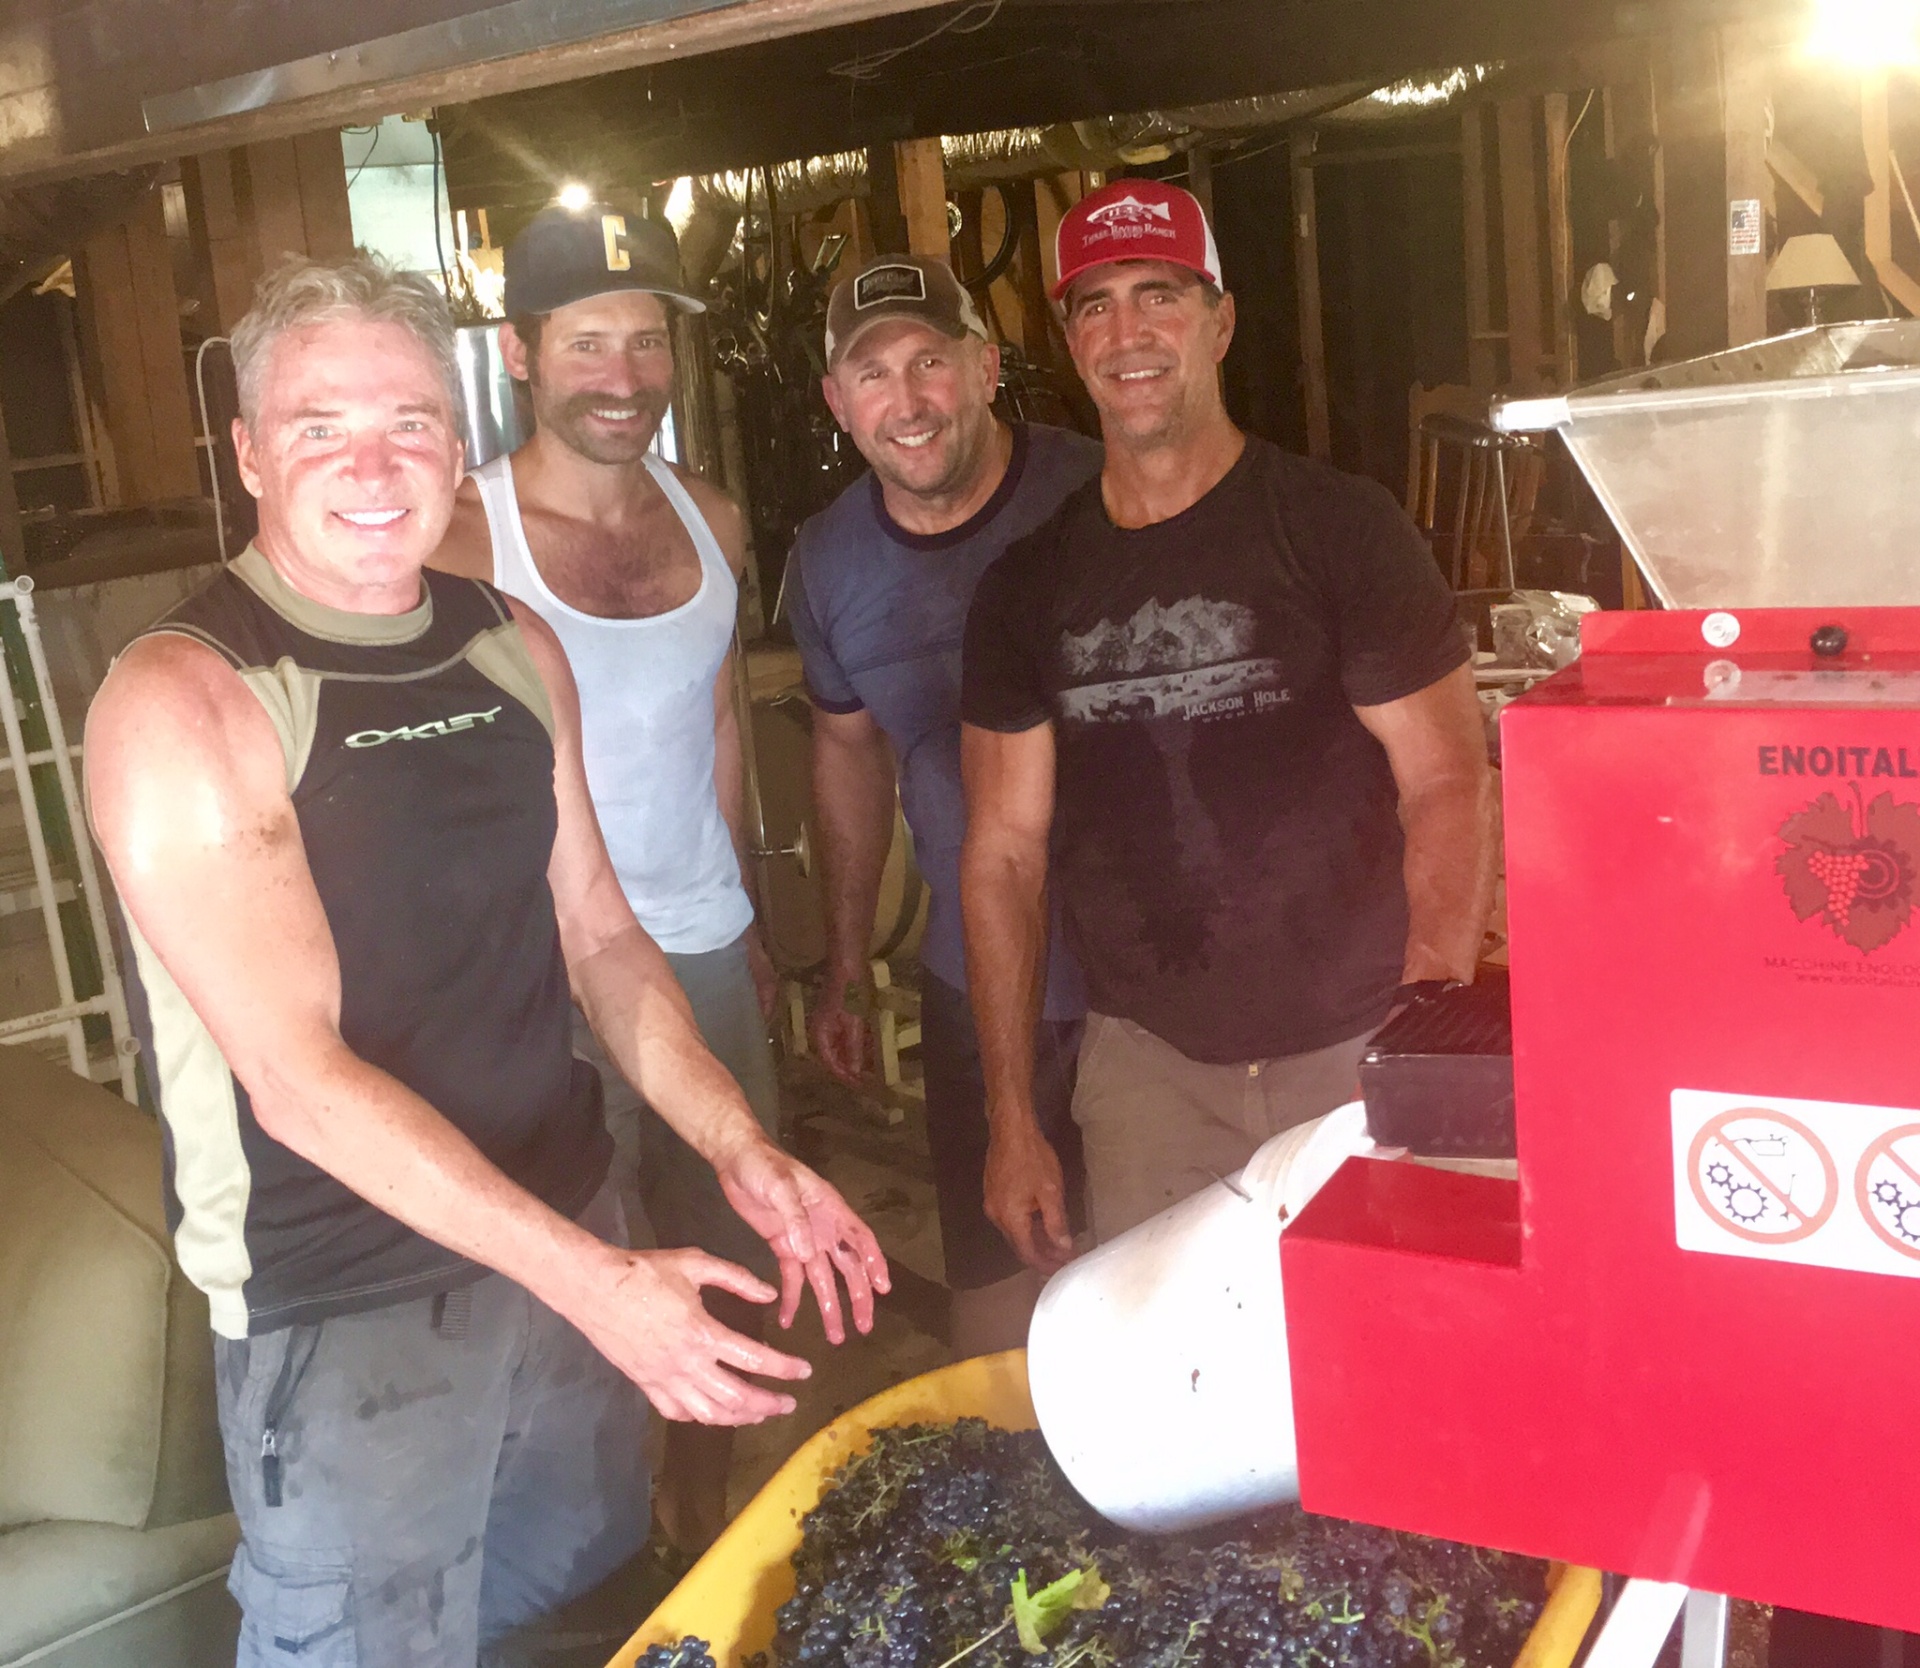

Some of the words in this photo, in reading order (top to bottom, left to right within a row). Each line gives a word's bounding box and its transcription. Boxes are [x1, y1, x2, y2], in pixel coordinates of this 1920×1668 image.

[602, 214, 631, 271] C
[1144, 223, 1176, 239] RANCH
[1182, 696, 1244, 721] JACKSON
[1253, 688, 1290, 707] HOLE
[345, 706, 502, 748] OAKLEY
[1758, 745, 1920, 778] ENOITAL
